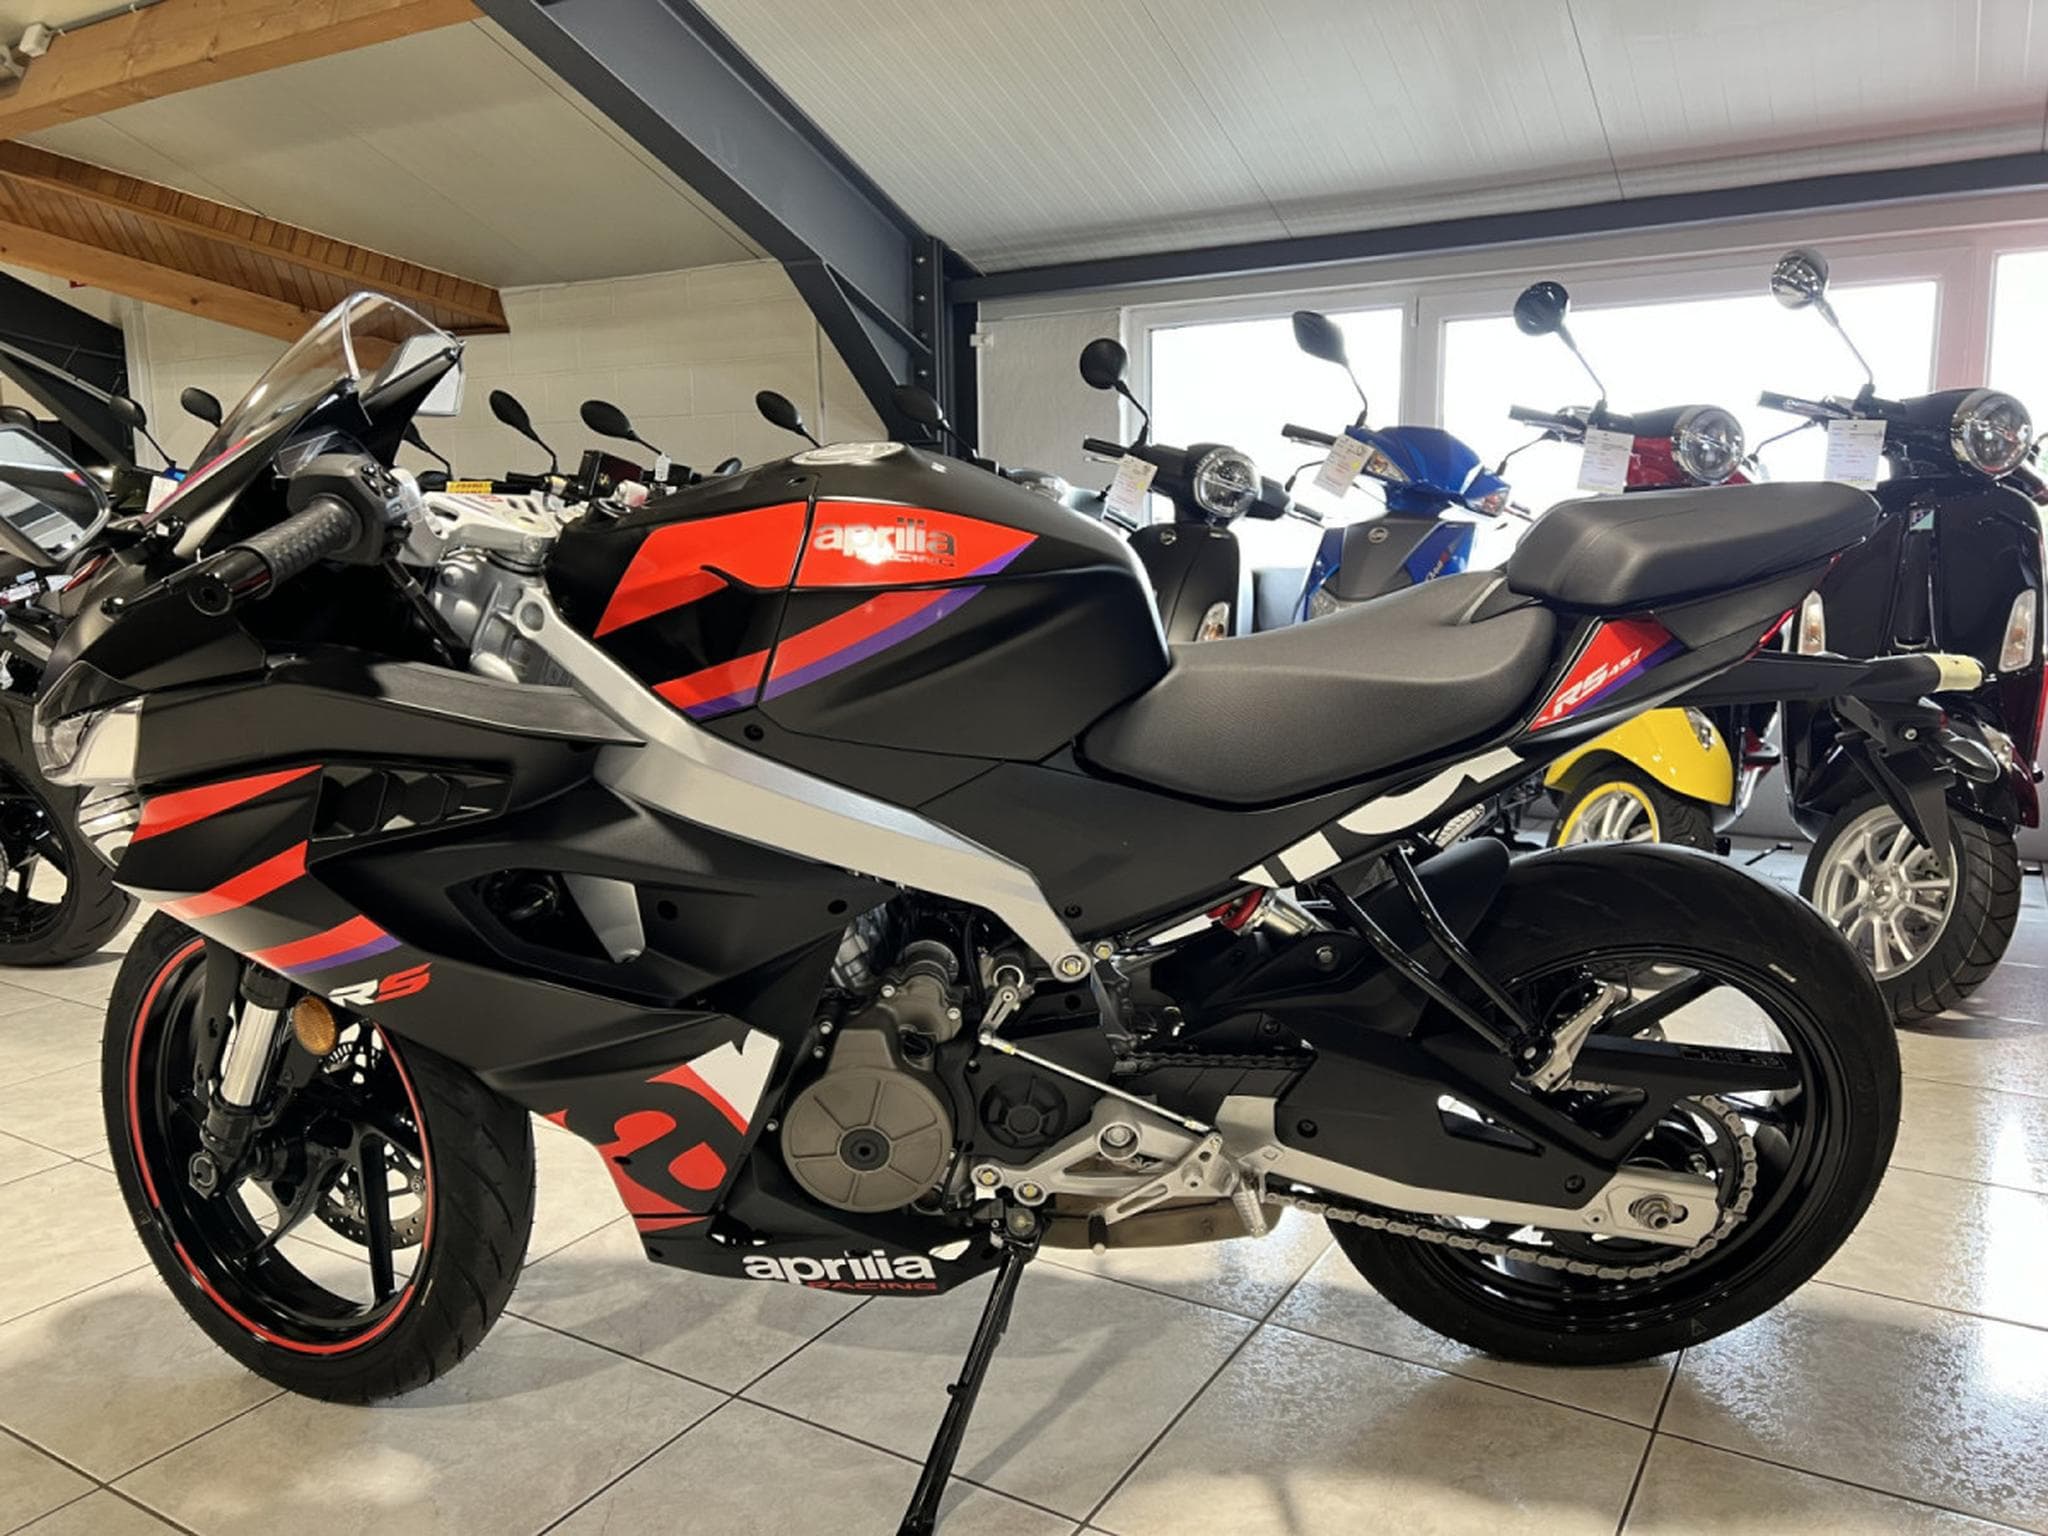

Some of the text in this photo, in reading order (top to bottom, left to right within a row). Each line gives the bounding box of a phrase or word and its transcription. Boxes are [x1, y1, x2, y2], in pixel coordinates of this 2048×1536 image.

[814, 517, 955, 557] aprilia
[1552, 662, 1609, 717] RS
[328, 961, 433, 1007] RS
[742, 1250, 936, 1285] aprilia
[807, 1280, 937, 1291] RACING
